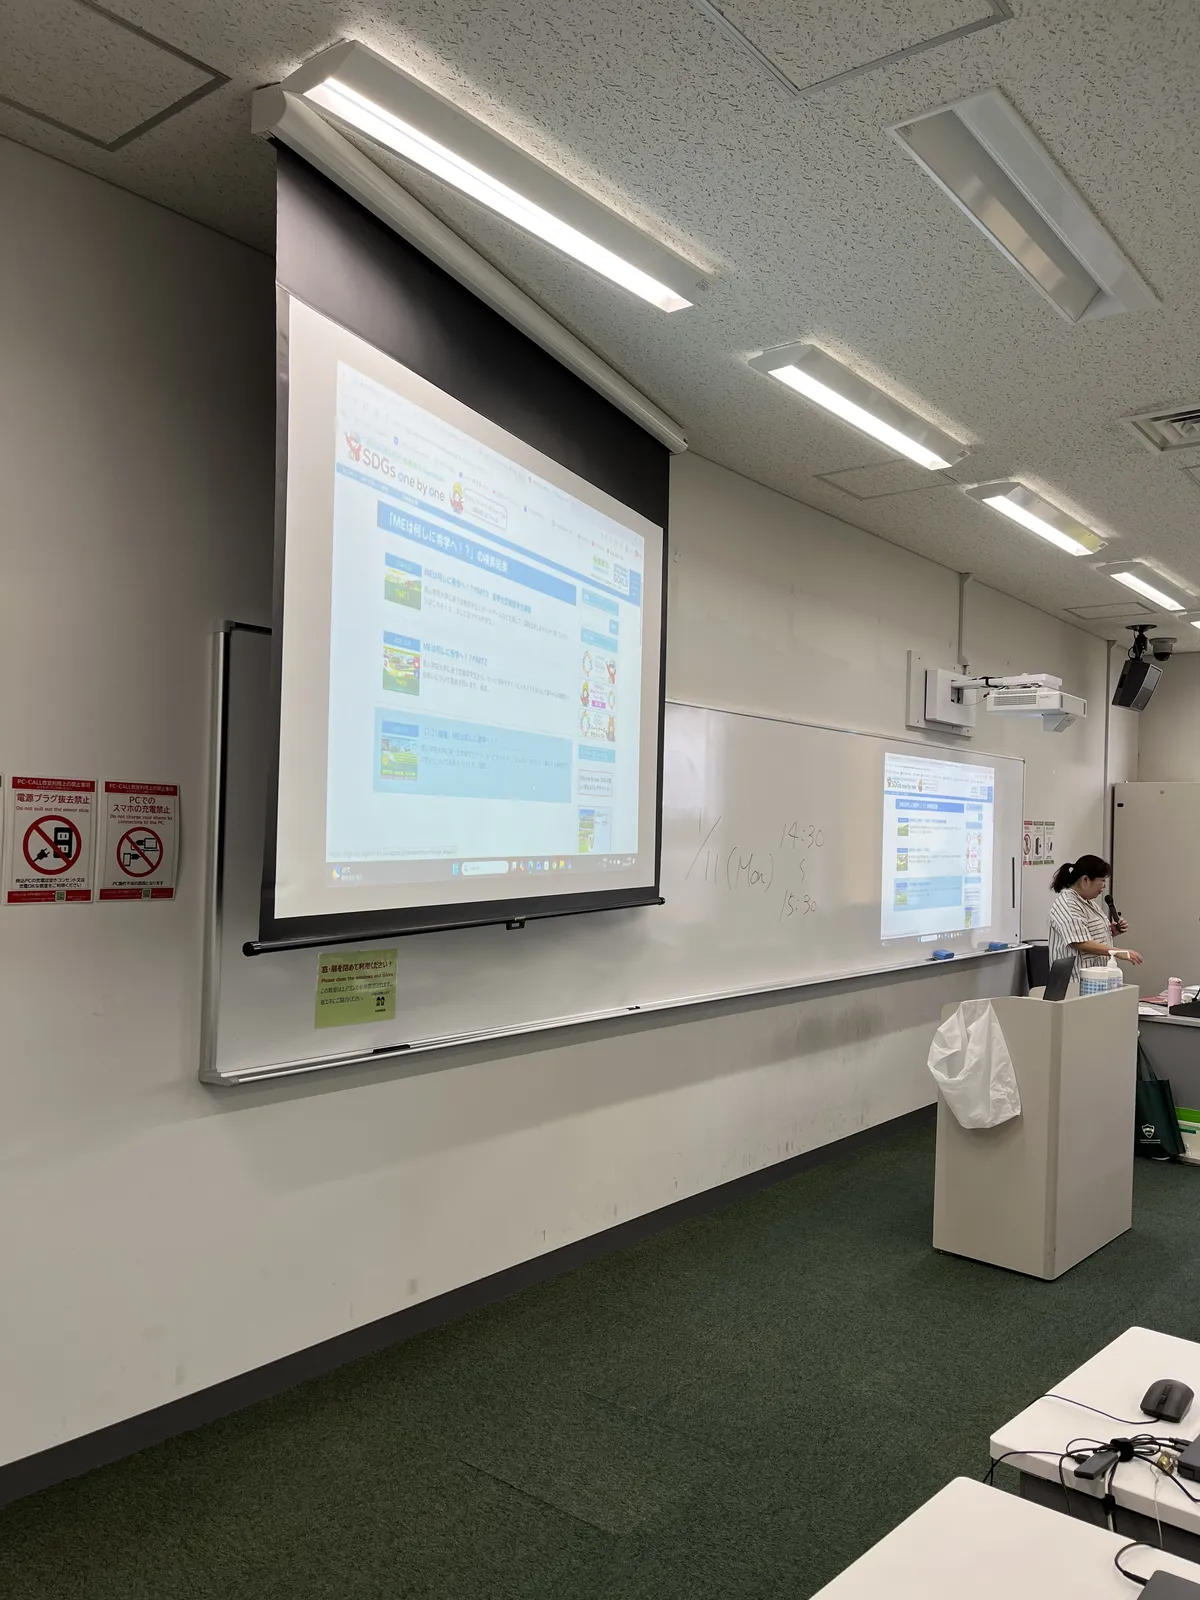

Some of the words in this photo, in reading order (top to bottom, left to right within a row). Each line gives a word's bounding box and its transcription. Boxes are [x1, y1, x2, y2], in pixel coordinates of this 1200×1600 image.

[363, 448, 396, 478] SDGs
[398, 471, 415, 488] one
[417, 478, 428, 496] by
[429, 483, 445, 502] one
[16, 793, 91, 805] 電源プラグ抜去禁止
[113, 804, 170, 814] スマホの充電禁止
[129, 796, 156, 805] PCでの
[780, 820, 825, 850] 14:30
[779, 889, 818, 922] 15:30
